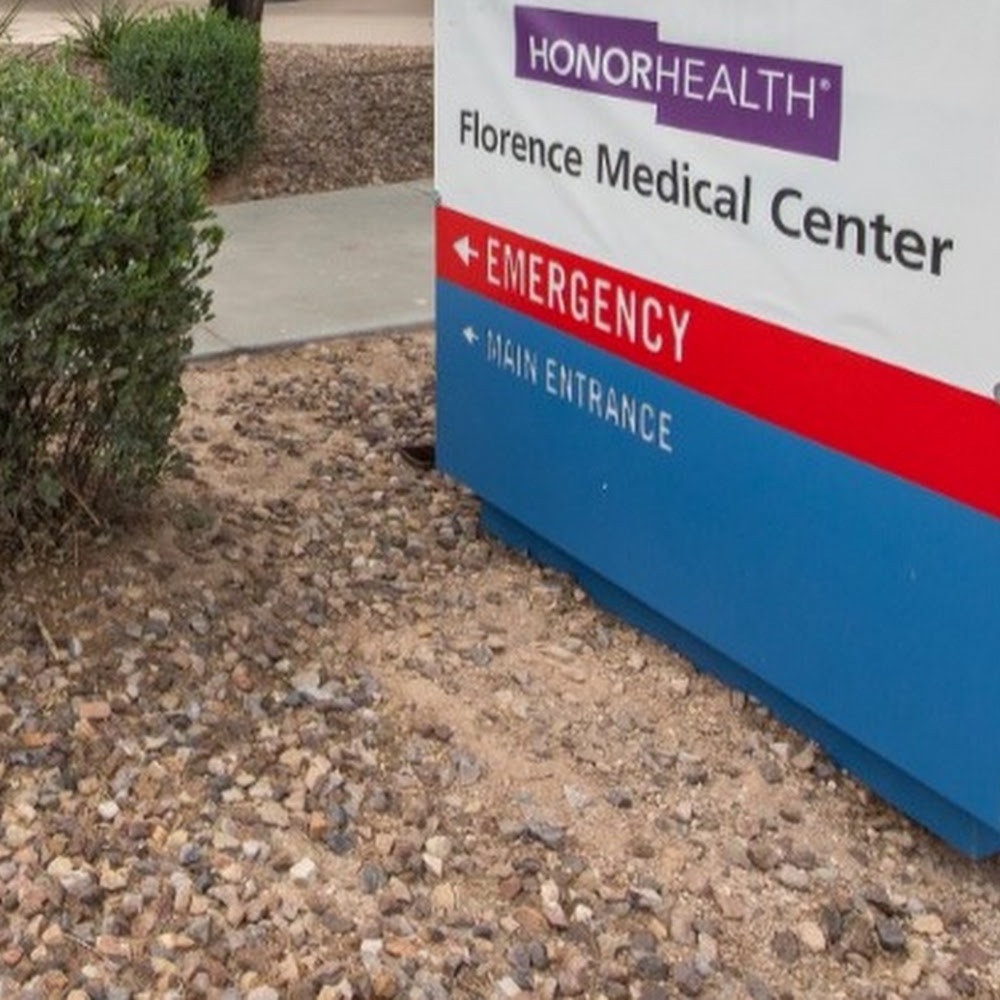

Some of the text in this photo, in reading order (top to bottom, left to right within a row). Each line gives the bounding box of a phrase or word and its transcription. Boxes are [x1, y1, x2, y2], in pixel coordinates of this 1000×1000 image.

[460, 109, 953, 276] Florence Medical Center
[487, 236, 690, 363] EMERGENCY
[487, 328, 672, 452] MAIN ENTRANCE
